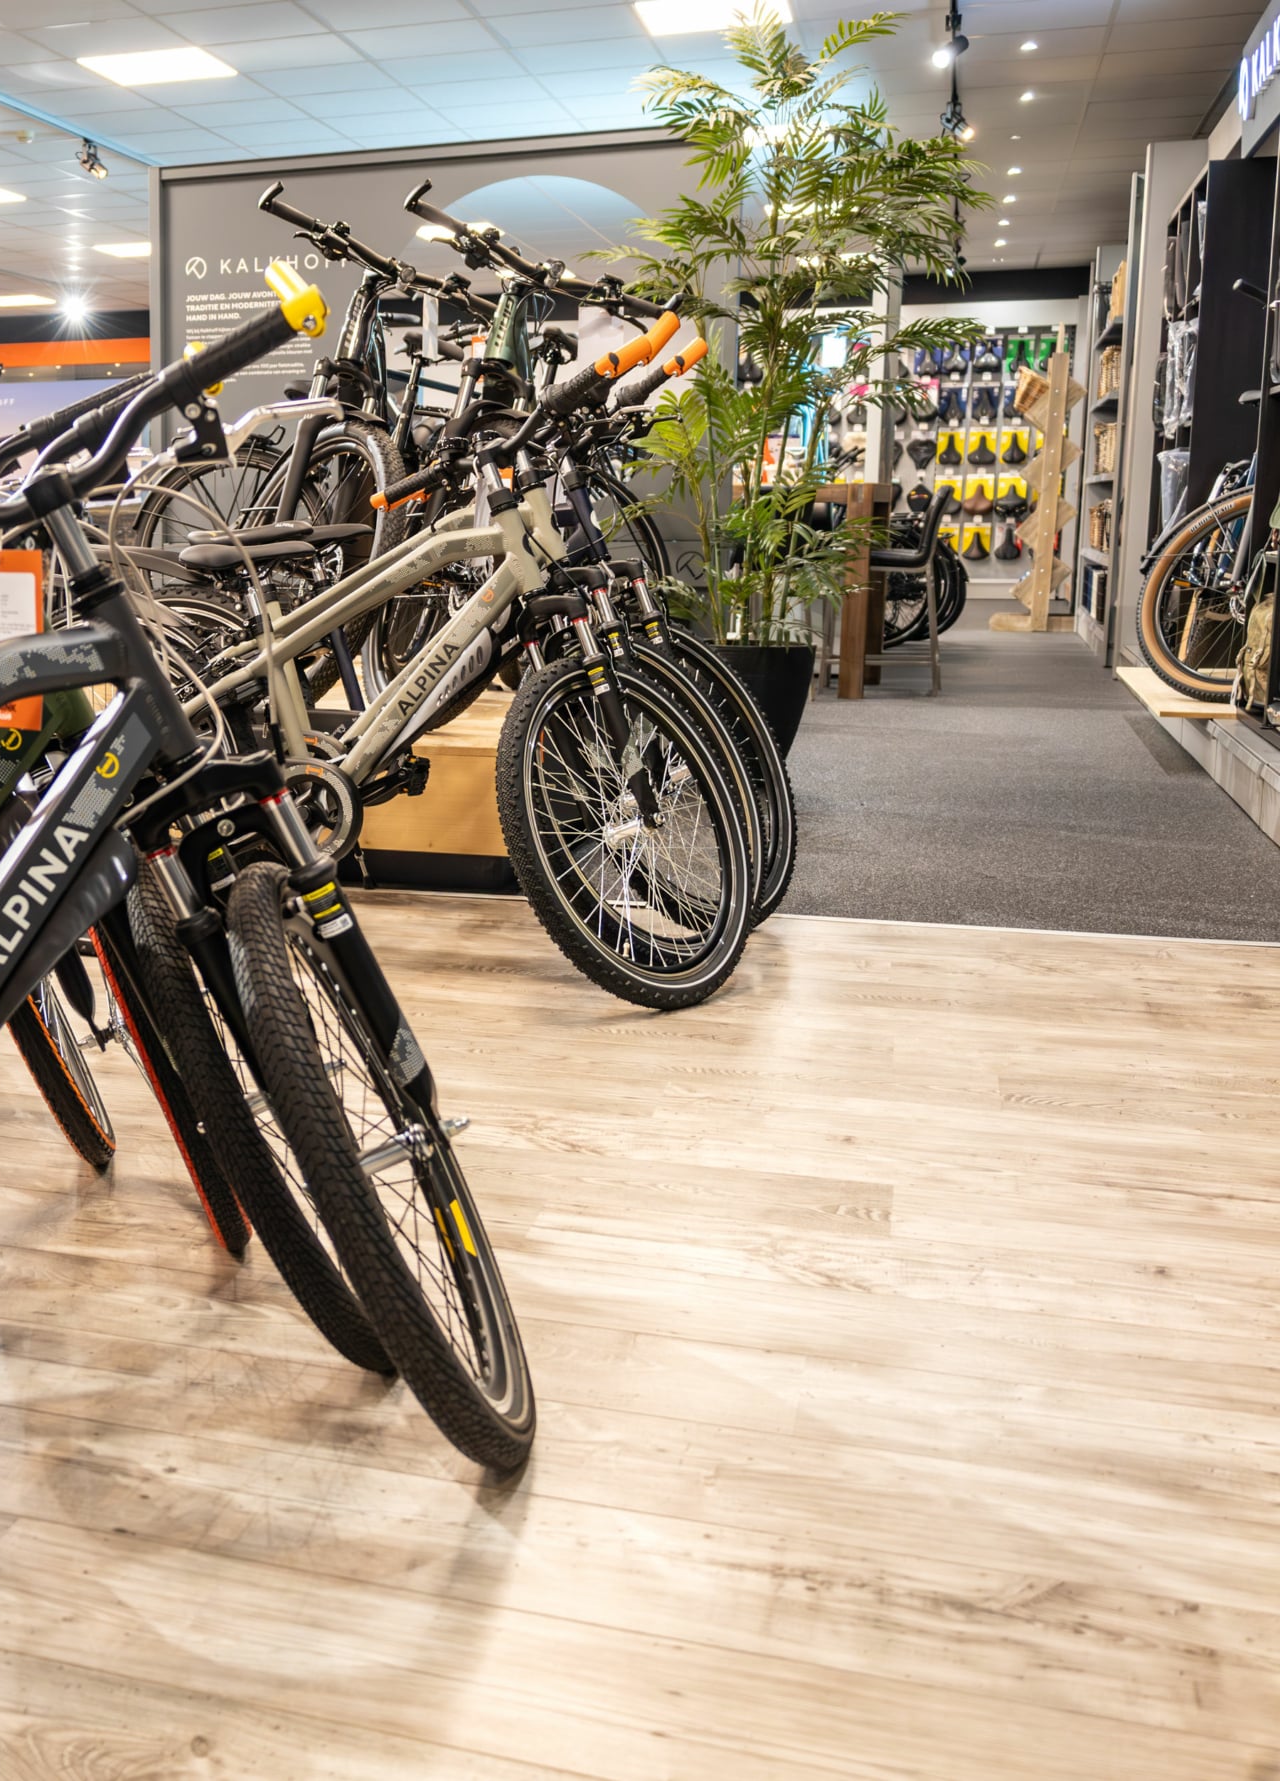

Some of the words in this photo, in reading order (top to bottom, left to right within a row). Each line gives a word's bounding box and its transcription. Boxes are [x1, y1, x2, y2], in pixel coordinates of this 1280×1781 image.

[228, 292, 251, 300] JOUW
[186, 303, 219, 312] TRADITIE
[218, 312, 241, 320] HAND.
[397, 642, 460, 717] ALPINA
